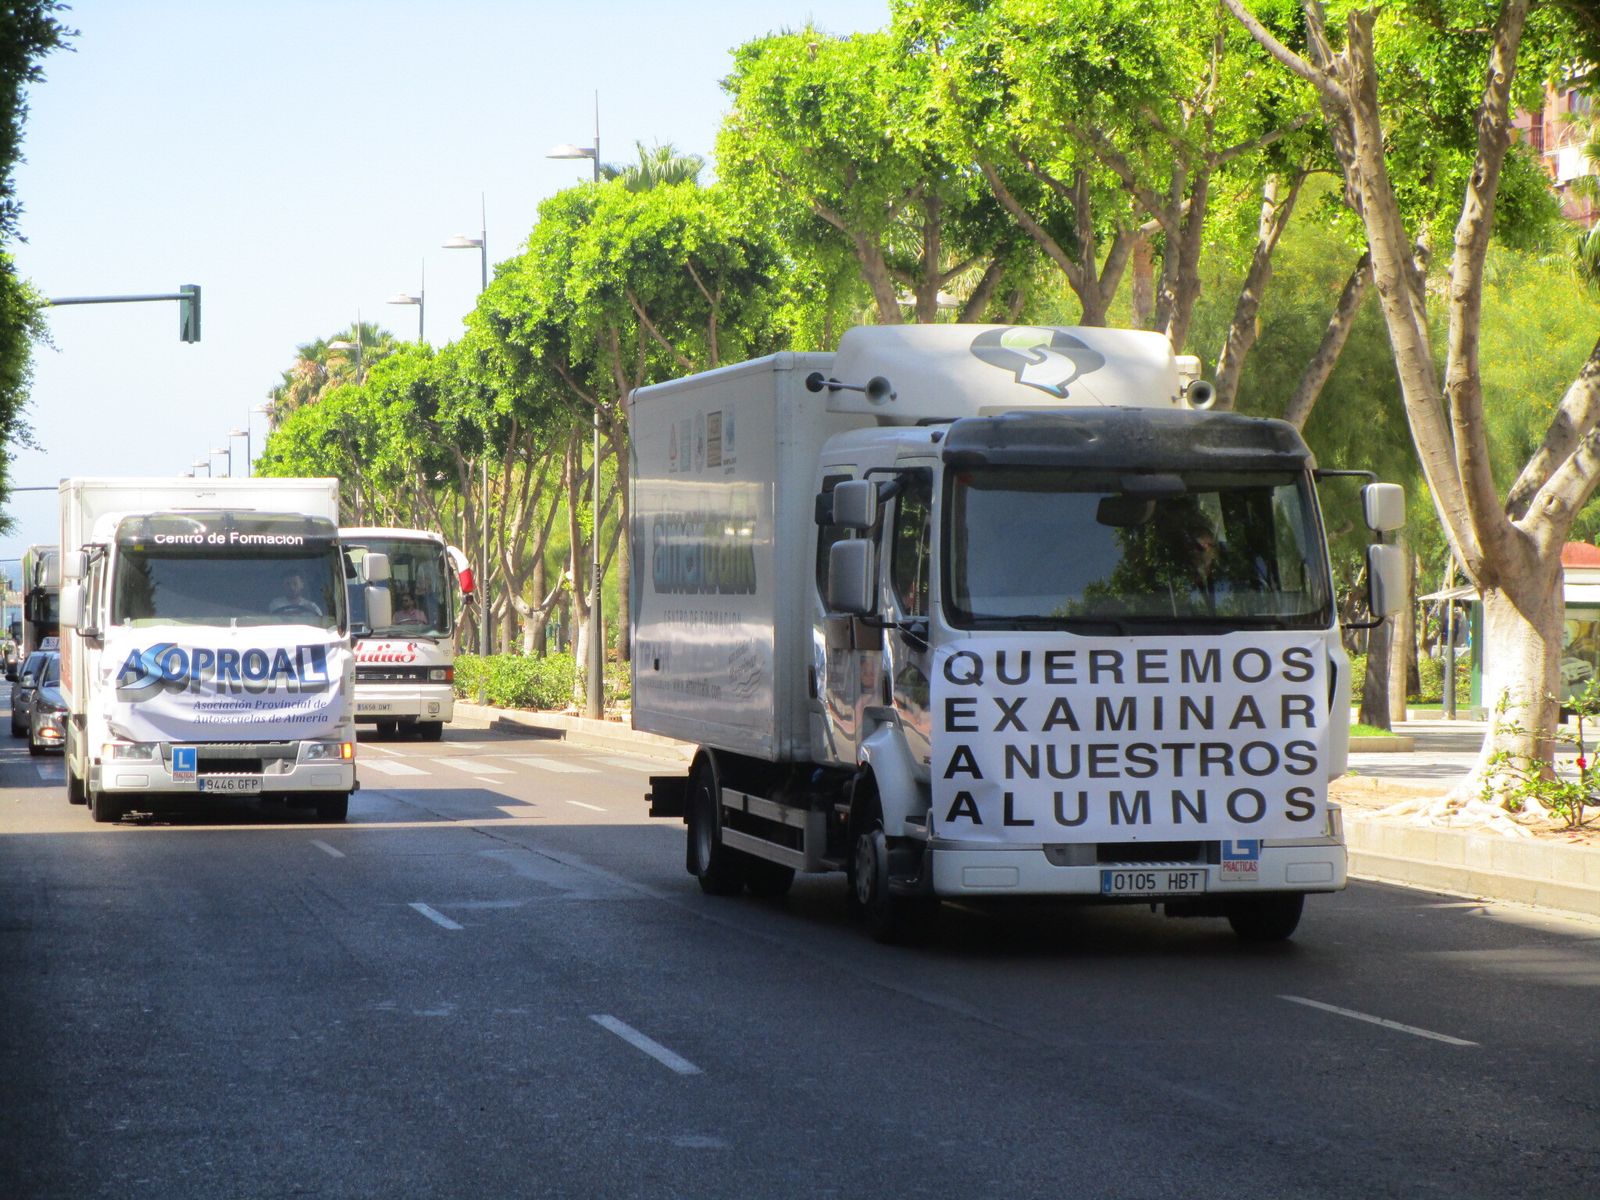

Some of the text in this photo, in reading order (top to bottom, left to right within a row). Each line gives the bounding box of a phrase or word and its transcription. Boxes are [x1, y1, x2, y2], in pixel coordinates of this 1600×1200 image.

[154, 533, 204, 544] Centro
[207, 532, 226, 544] de
[116, 643, 329, 696] ASOPROAL
[943, 647, 1315, 686] QUEREMOS
[193, 700, 327, 710] Asociación Provincial de
[944, 694, 1317, 733] EXAMINAR
[193, 713, 328, 724] Autoescuelas de Almería
[178, 751, 190, 769] L
[943, 740, 1318, 780] A NUESTROS
[206, 779, 258, 790] 9446 GFP
[945, 787, 1316, 827] ALUMNOS
[1222, 861, 1258, 872] PRACTICAS
[1114, 873, 1199, 890] 0105 HBT
